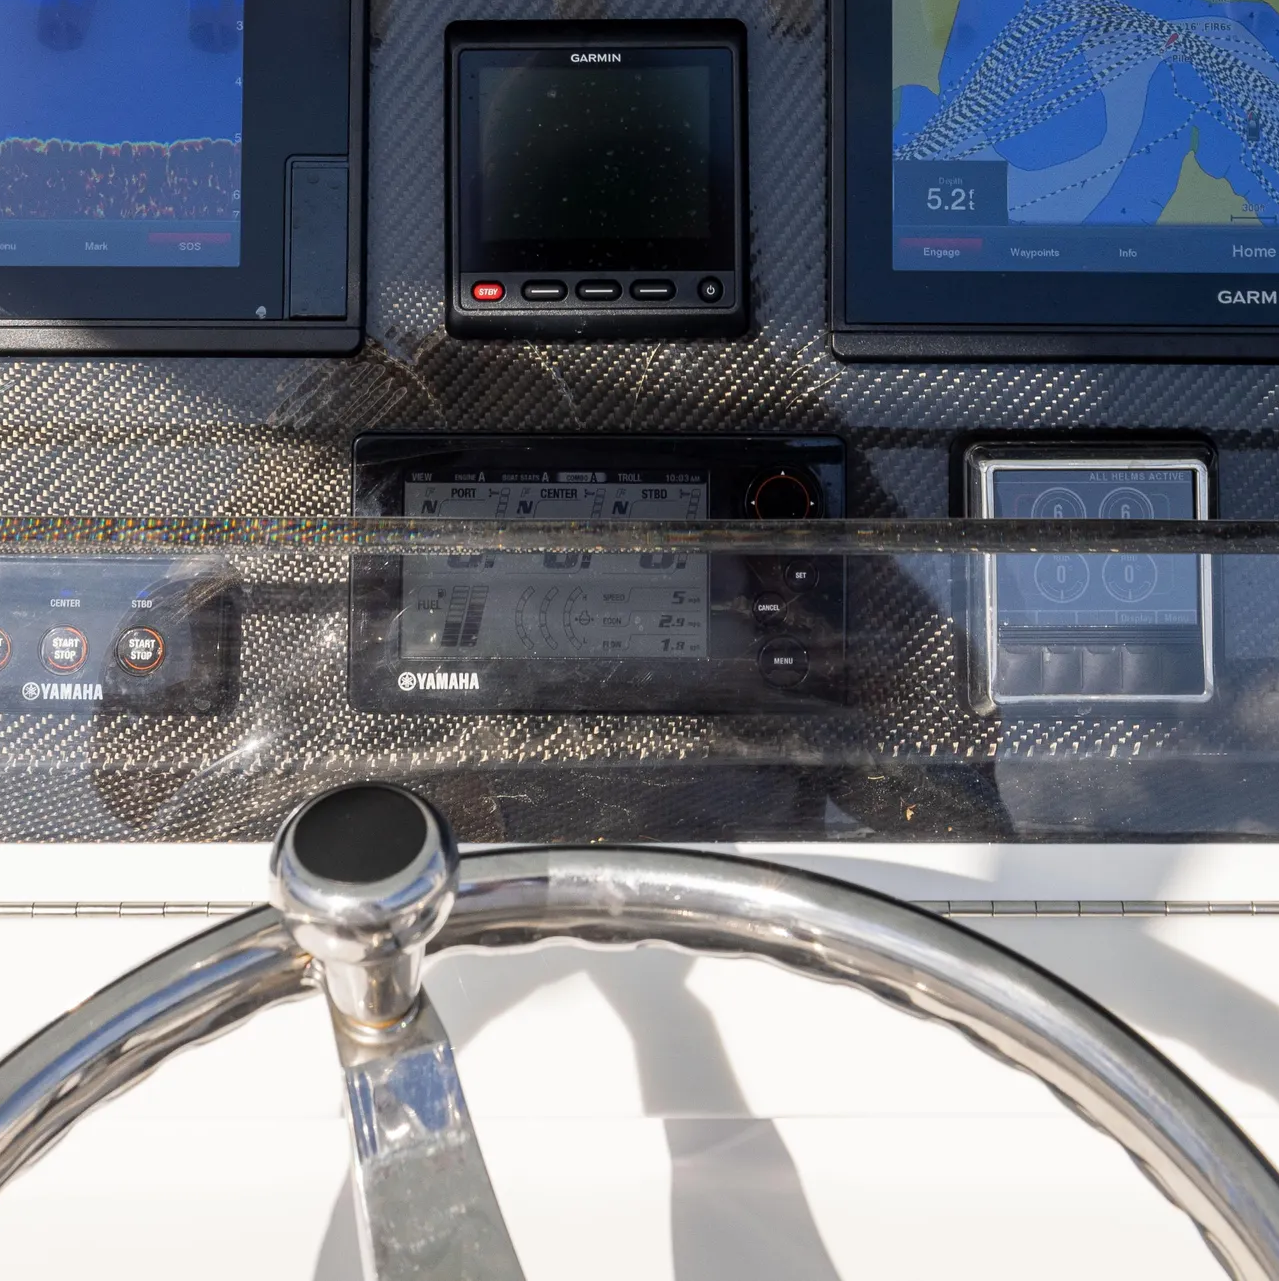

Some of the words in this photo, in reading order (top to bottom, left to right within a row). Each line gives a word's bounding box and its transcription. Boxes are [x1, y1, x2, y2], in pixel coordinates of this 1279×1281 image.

[570, 53, 621, 63] GARMIN
[926, 187, 966, 211] 5.2
[85, 241, 109, 251] Mark
[179, 242, 202, 251] SOS
[923, 247, 961, 259] Engage
[1010, 247, 1060, 259] Waypoints
[1118, 249, 1138, 258] Info
[1232, 244, 1277, 258] Home
[478, 287, 498, 296] STBY
[411, 473, 433, 482] VIEW
[454, 474, 477, 482] ENGINE
[478, 472, 486, 482] A
[542, 472, 549, 482] A
[590, 472, 598, 483] A
[618, 473, 642, 482] TROLL
[1089, 472, 1108, 481] ALL
[1111, 472, 1145, 481] HELMS
[1148, 472, 1184, 481] ACTIVE
[451, 488, 477, 499] PORT
[540, 488, 578, 499] CENTER
[641, 488, 668, 500] STBD
[421, 500, 438, 514] N
[517, 500, 533, 514] N
[612, 501, 629, 515] N
[50, 598, 81, 608] CENTER
[602, 593, 626, 602] SPEED
[671, 590, 687, 605] 5
[131, 599, 153, 609] STBD
[418, 600, 440, 610] FUEL
[658, 614, 685, 628] 2.9
[52, 638, 79, 648] START
[128, 639, 156, 649] START
[661, 638, 686, 652] 1.8
[54, 650, 77, 660] STOP
[130, 650, 153, 661] STOP
[773, 657, 794, 665] MENU
[416, 672, 480, 690] YAMAHA
[41, 683, 103, 700] YAMAHA
